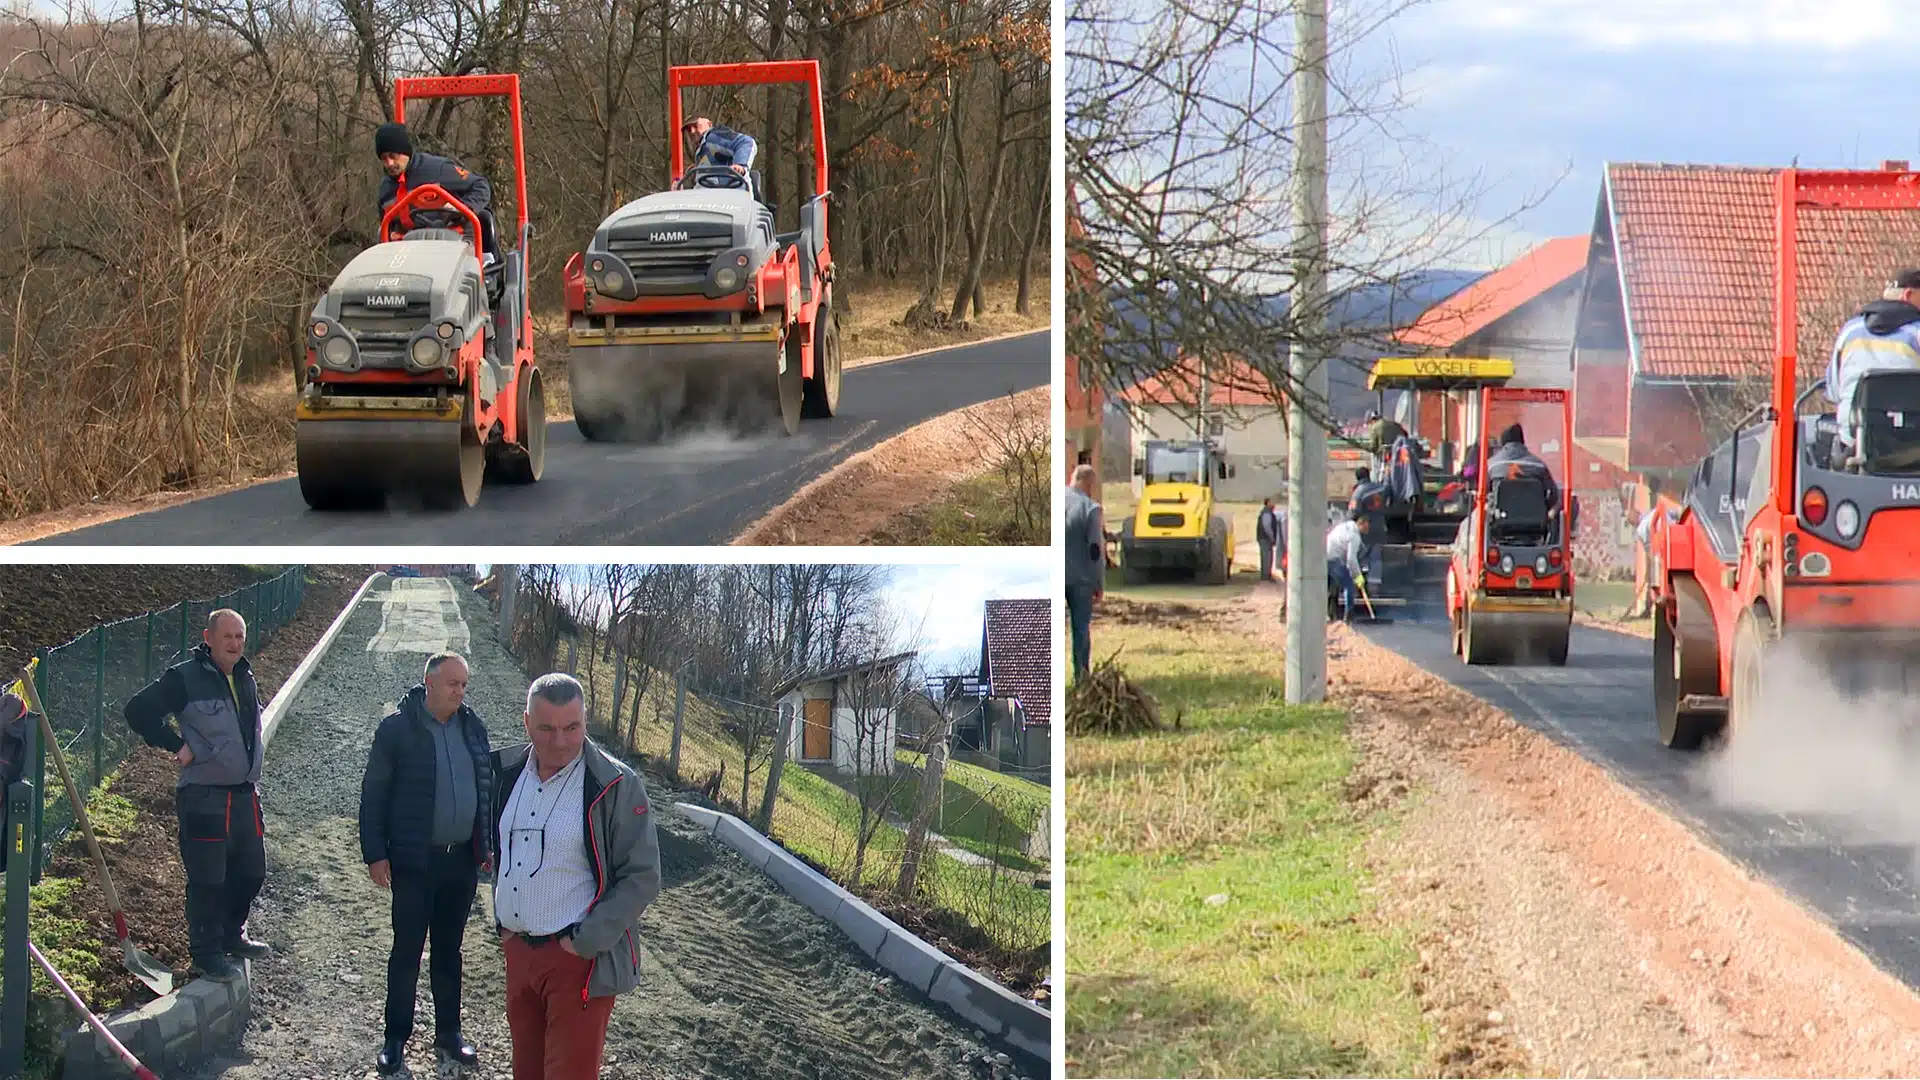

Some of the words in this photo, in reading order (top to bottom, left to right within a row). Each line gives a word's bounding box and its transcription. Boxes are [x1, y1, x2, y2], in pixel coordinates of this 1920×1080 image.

[650, 231, 688, 242] HAMM
[366, 295, 406, 306] HAMM
[1891, 484, 1920, 500] HA
